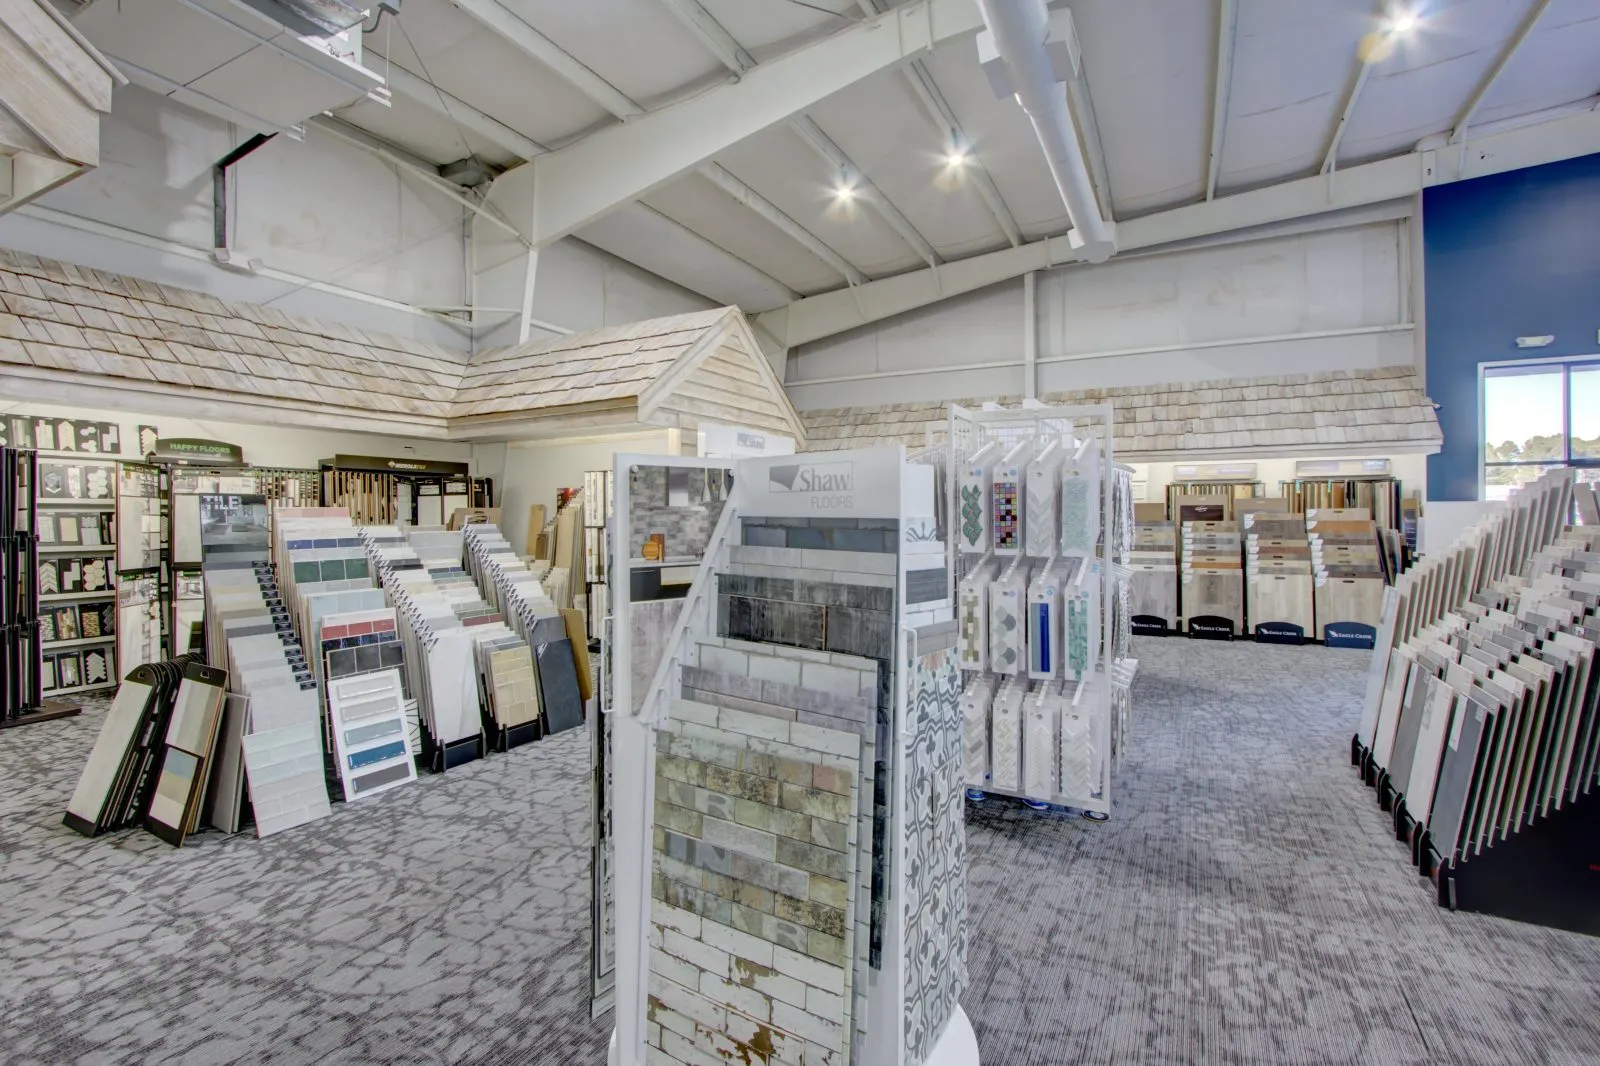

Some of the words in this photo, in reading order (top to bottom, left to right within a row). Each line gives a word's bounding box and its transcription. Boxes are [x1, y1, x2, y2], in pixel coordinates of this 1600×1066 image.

[170, 443, 197, 452] HAPPY
[199, 445, 231, 454] FLOORS
[799, 467, 851, 492] Shaw
[202, 495, 239, 510] TILE
[811, 496, 853, 509] FLOORS
